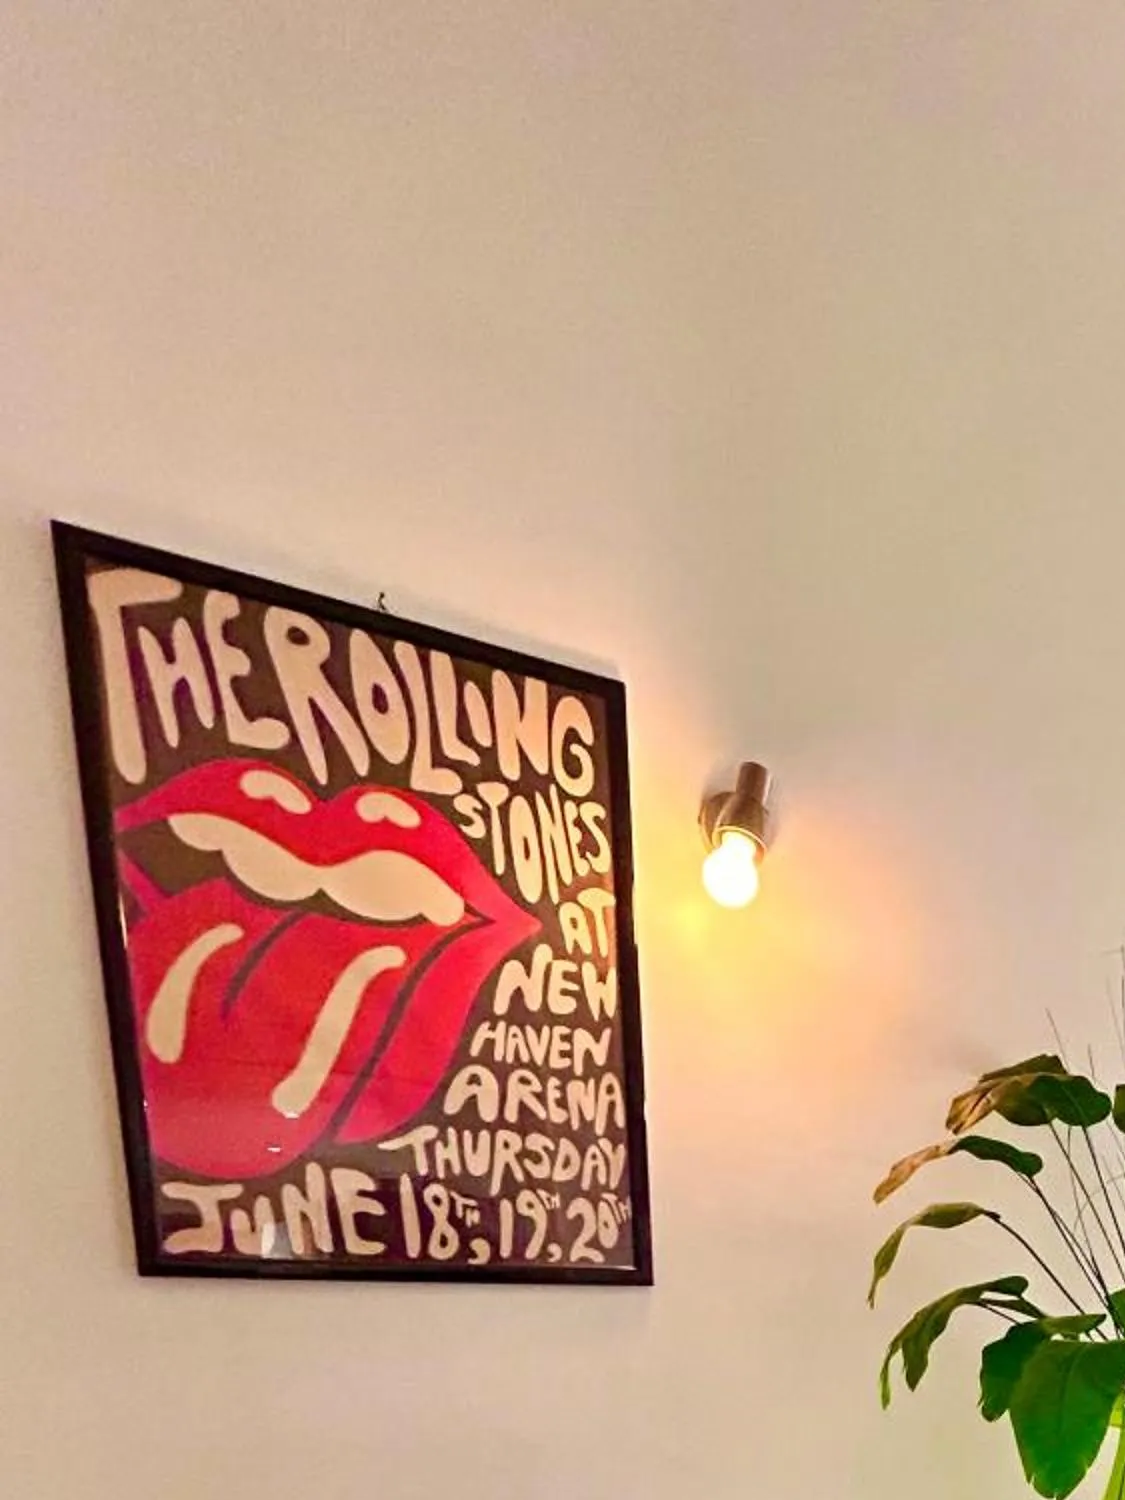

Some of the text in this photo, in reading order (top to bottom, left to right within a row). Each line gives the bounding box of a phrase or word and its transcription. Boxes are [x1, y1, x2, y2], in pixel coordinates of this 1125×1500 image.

[86, 567, 595, 797] THE ROLLING
[452, 781, 612, 904] STONES
[558, 888, 616, 958] AT
[493, 943, 617, 1022] NEW
[470, 1020, 612, 1076] HAVEN
[443, 1064, 626, 1136] ARENA
[378, 1125, 626, 1197] THURSDAY
[161, 1161, 387, 1259] JUNE
